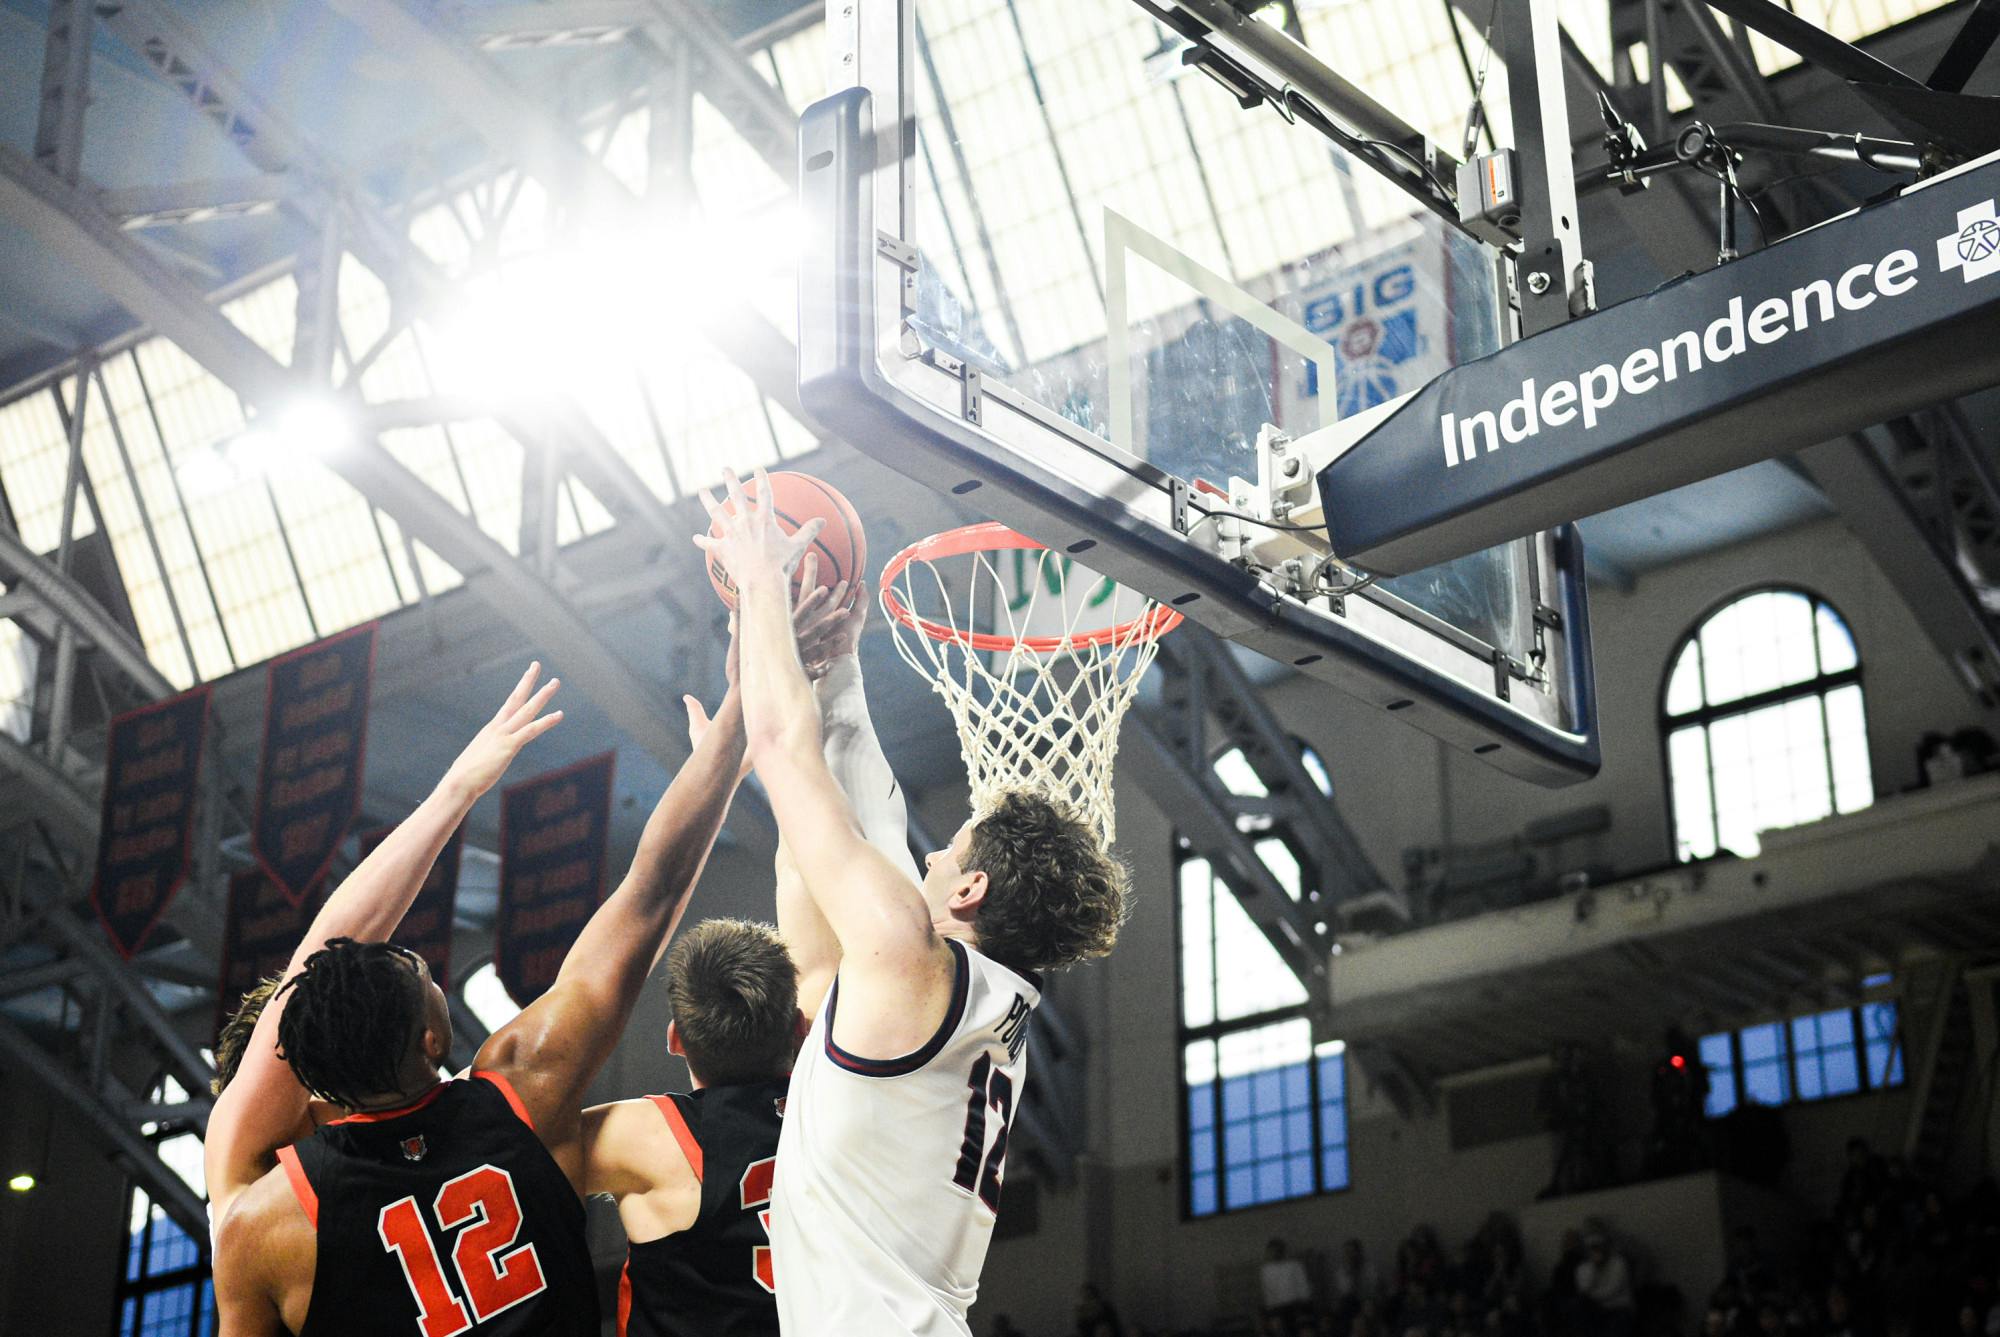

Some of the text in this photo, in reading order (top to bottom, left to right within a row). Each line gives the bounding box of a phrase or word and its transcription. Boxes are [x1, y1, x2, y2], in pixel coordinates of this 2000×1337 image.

[1440, 248, 1919, 468] Independence
[952, 1049, 1012, 1216] 12
[377, 1163, 548, 1337] 12
